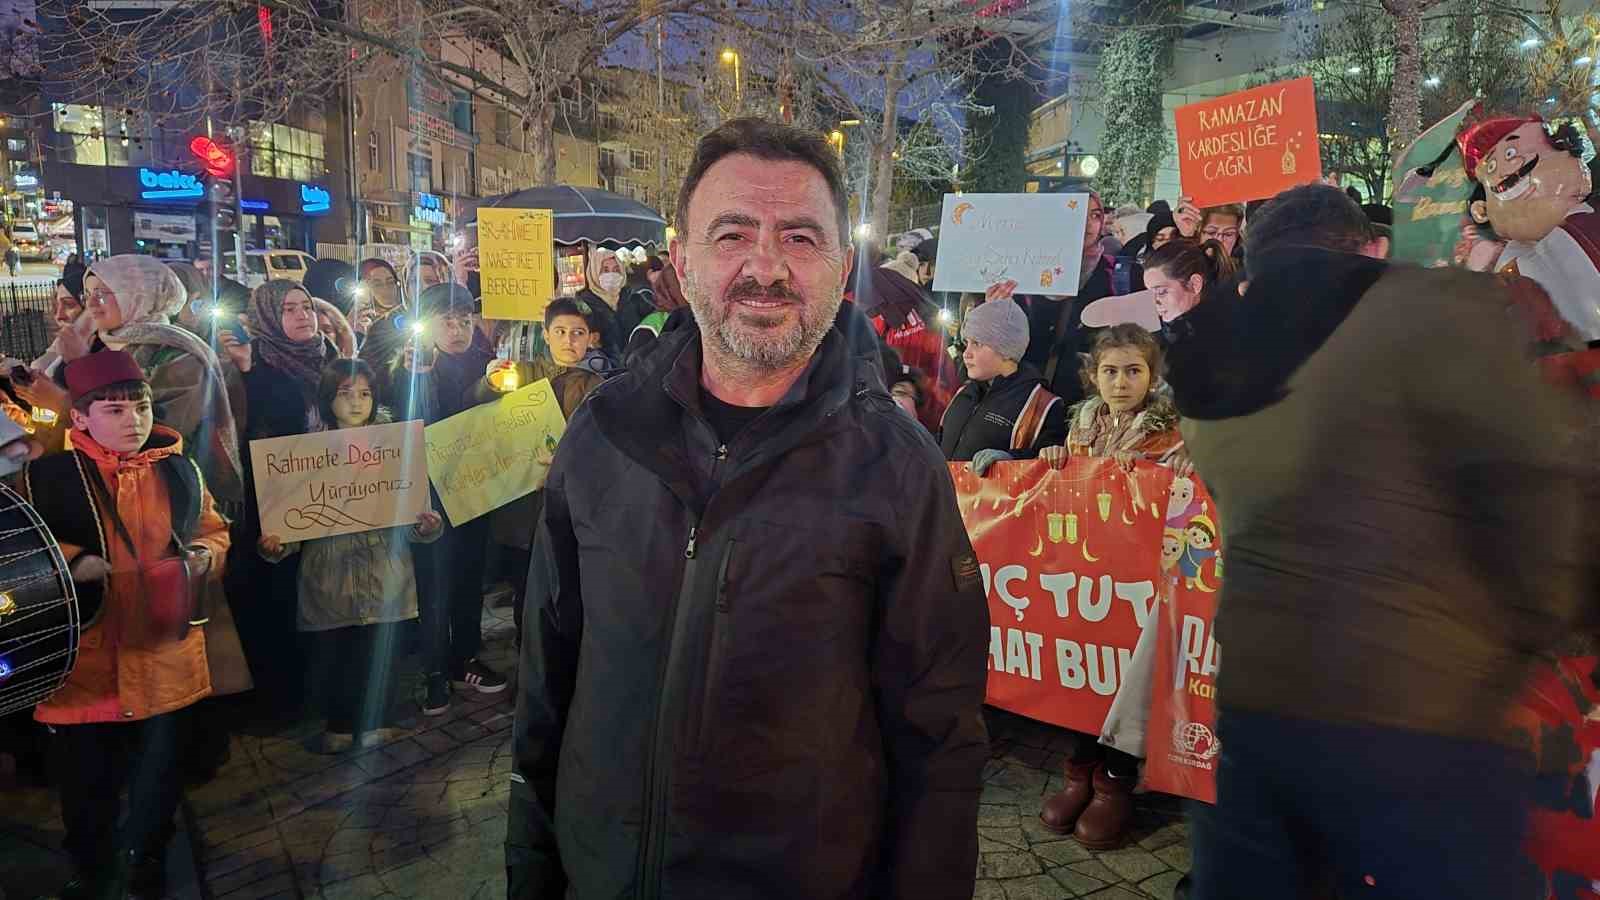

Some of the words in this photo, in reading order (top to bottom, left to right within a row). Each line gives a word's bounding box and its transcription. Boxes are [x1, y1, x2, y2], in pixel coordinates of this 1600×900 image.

[1198, 88, 1286, 131] RAMAZAN
[265, 448, 339, 476] Rahmete
[1040, 572, 1155, 629] TUT
